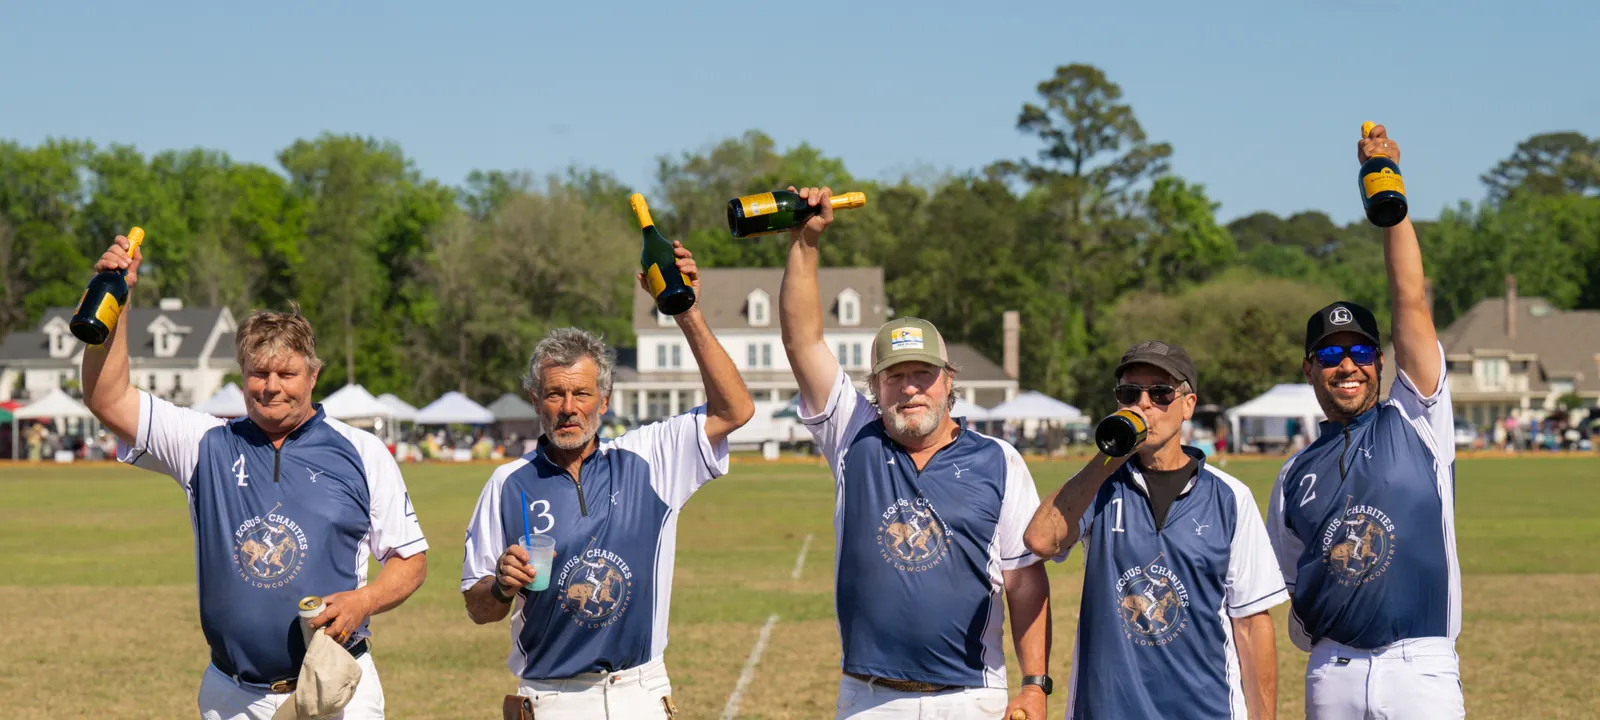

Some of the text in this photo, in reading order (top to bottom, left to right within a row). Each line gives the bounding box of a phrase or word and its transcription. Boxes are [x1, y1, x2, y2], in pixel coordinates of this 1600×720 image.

[231, 453, 249, 487] 4
[1299, 473, 1317, 508] 2
[529, 499, 555, 534] 3
[882, 497, 909, 520] EQUUS
[1111, 497, 1125, 533] 1
[235, 513, 308, 551] EQUUS CHARITIES
[1322, 504, 1395, 552] EQUUS CHARITIES
[251, 560, 304, 589] LOWCOUNTRY
[557, 548, 633, 587] EQUUS CHARITIES
[894, 546, 949, 572] LOWCOUNTRY
[1116, 564, 1190, 608] EQUUS CHARITIES
[587, 590, 632, 629] LOWCOUNTRY
[1134, 617, 1188, 647] LOWCOUNTRY
